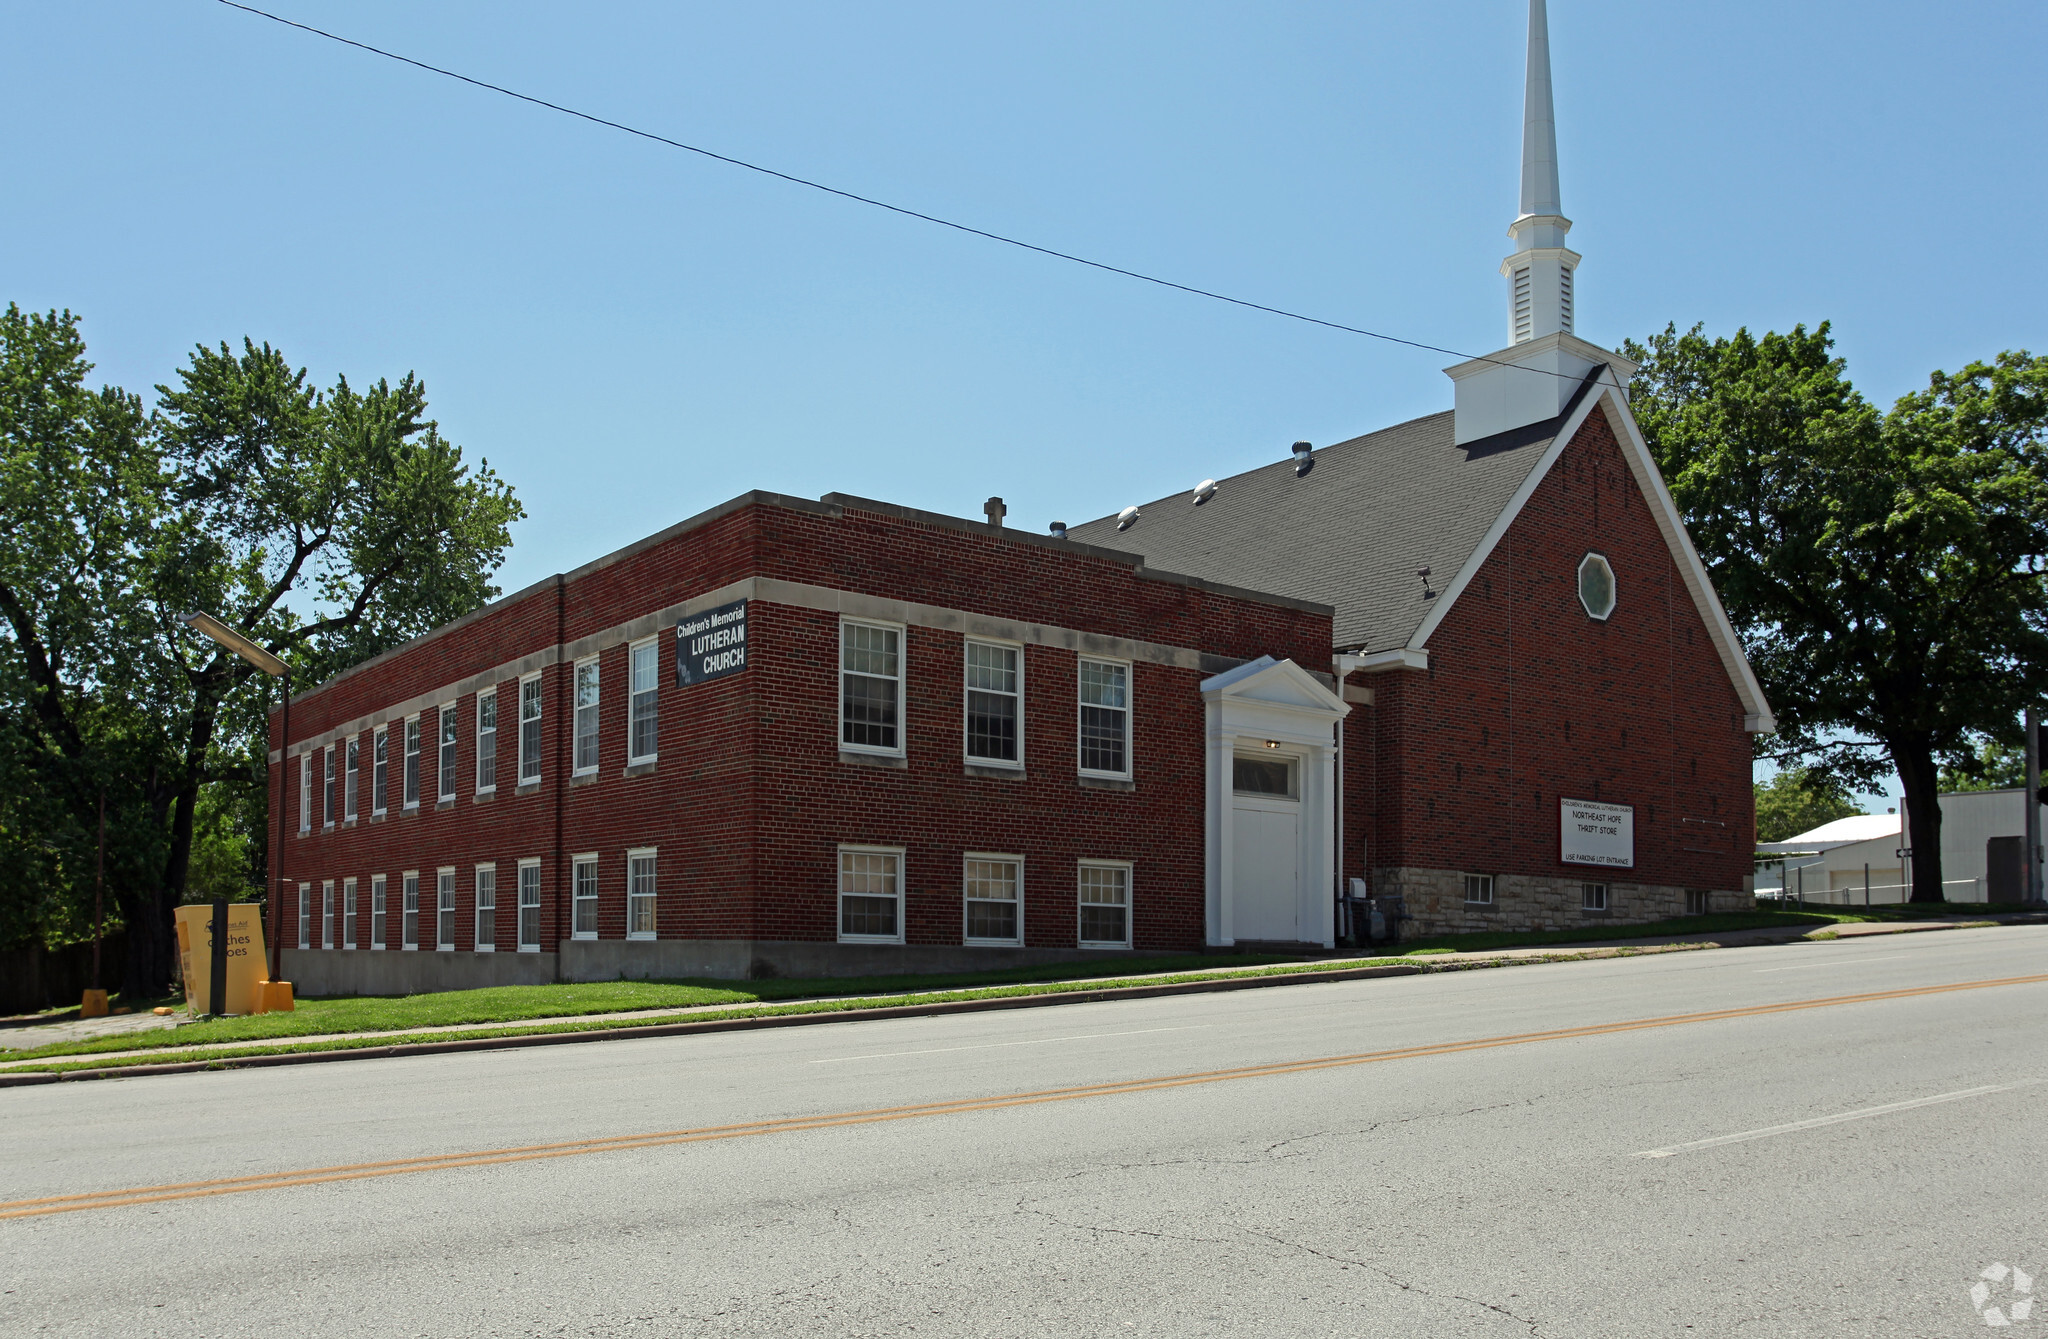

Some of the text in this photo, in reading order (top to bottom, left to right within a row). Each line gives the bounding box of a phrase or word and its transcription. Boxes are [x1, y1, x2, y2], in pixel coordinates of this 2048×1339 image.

[677, 605, 744, 639] Children's Memorial
[692, 625, 744, 656] LUTHERAN
[703, 647, 744, 674] CHURCH
[1572, 810, 1621, 824] NORTHEAST HOPE
[1577, 824, 1617, 836] THRIFT STORE
[1566, 853, 1575, 861] USE
[1606, 857, 1629, 865] ENTRANCE
[208, 934, 250, 947] cthes
